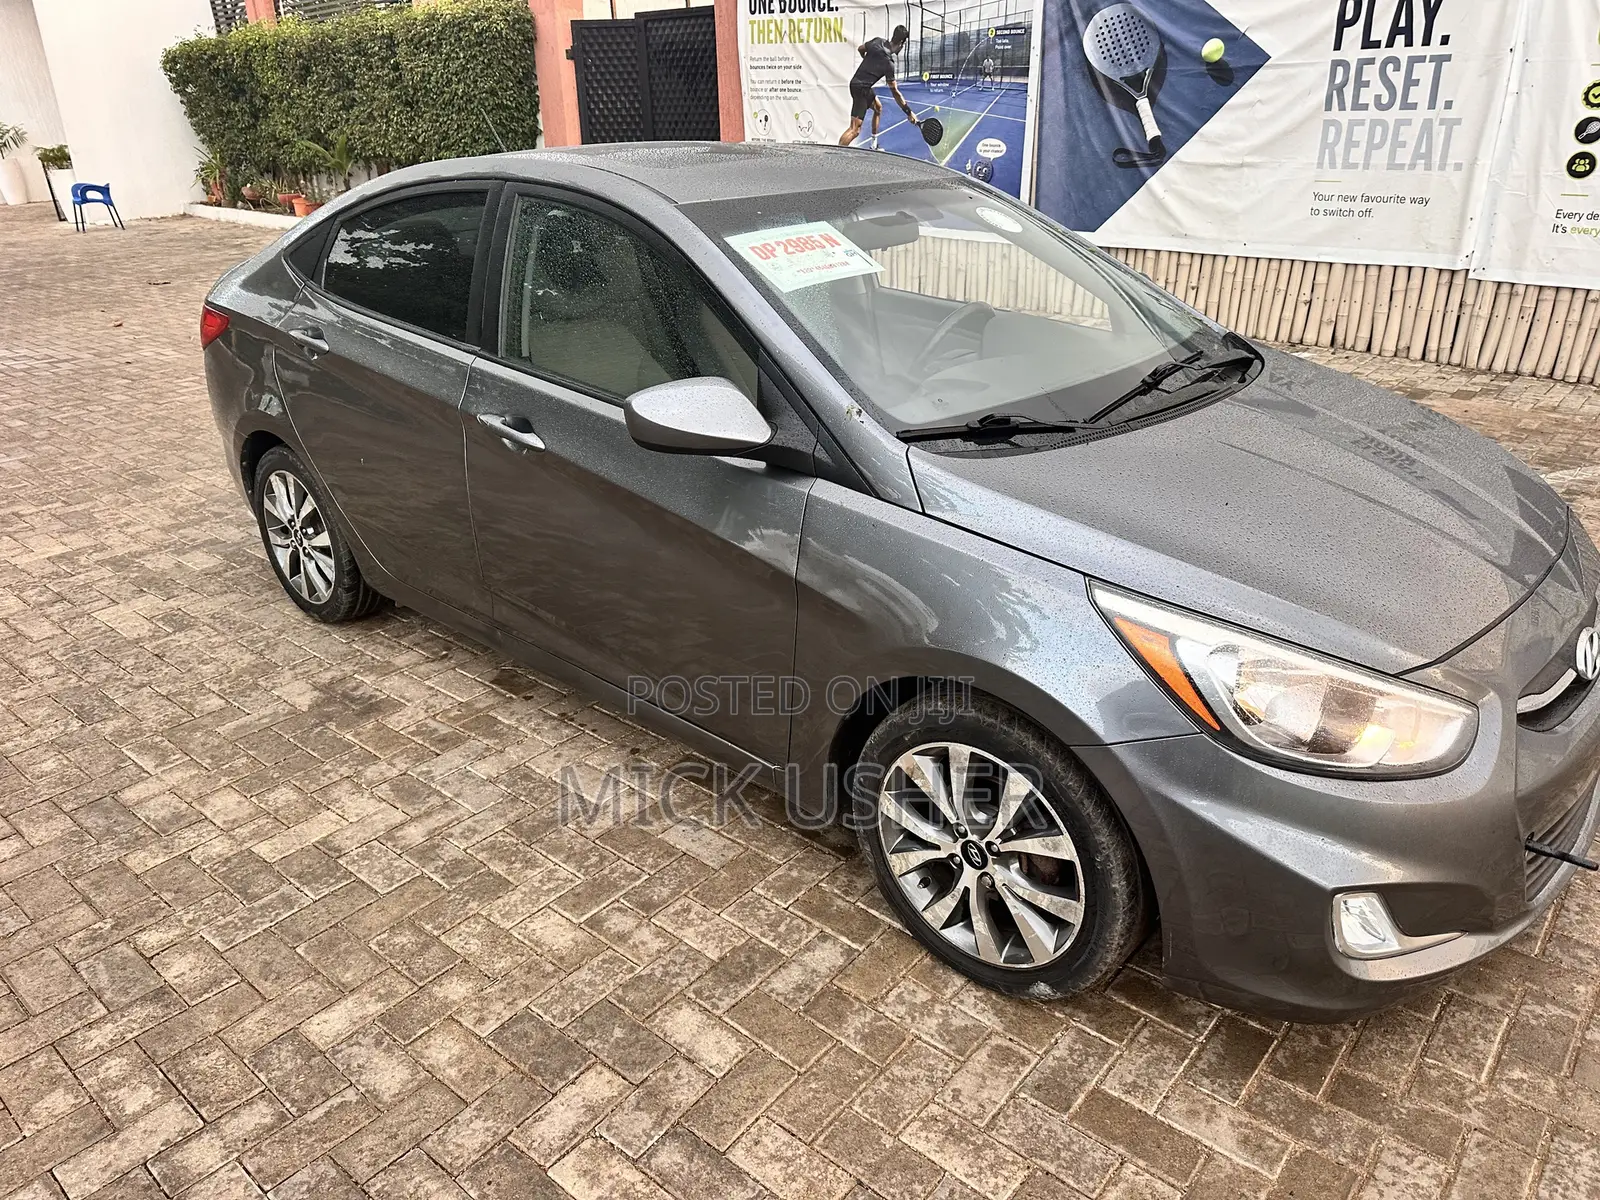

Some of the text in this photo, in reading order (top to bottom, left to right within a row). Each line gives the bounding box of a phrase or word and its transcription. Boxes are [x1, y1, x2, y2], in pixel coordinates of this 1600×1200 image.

[748, 16, 848, 45] THEN RETURN.
[1333, 0, 1451, 51] PLAY.
[1324, 53, 1453, 112] RESET.
[1316, 117, 1463, 172] REPEAT.
[1312, 191, 1431, 207] Your new favourite way
[1310, 207, 1374, 218] to switch off.
[1555, 208, 1600, 222] Every de
[1552, 223, 1567, 234] It's
[774, 235, 827, 255] 2985
[818, 233, 842, 248] N
